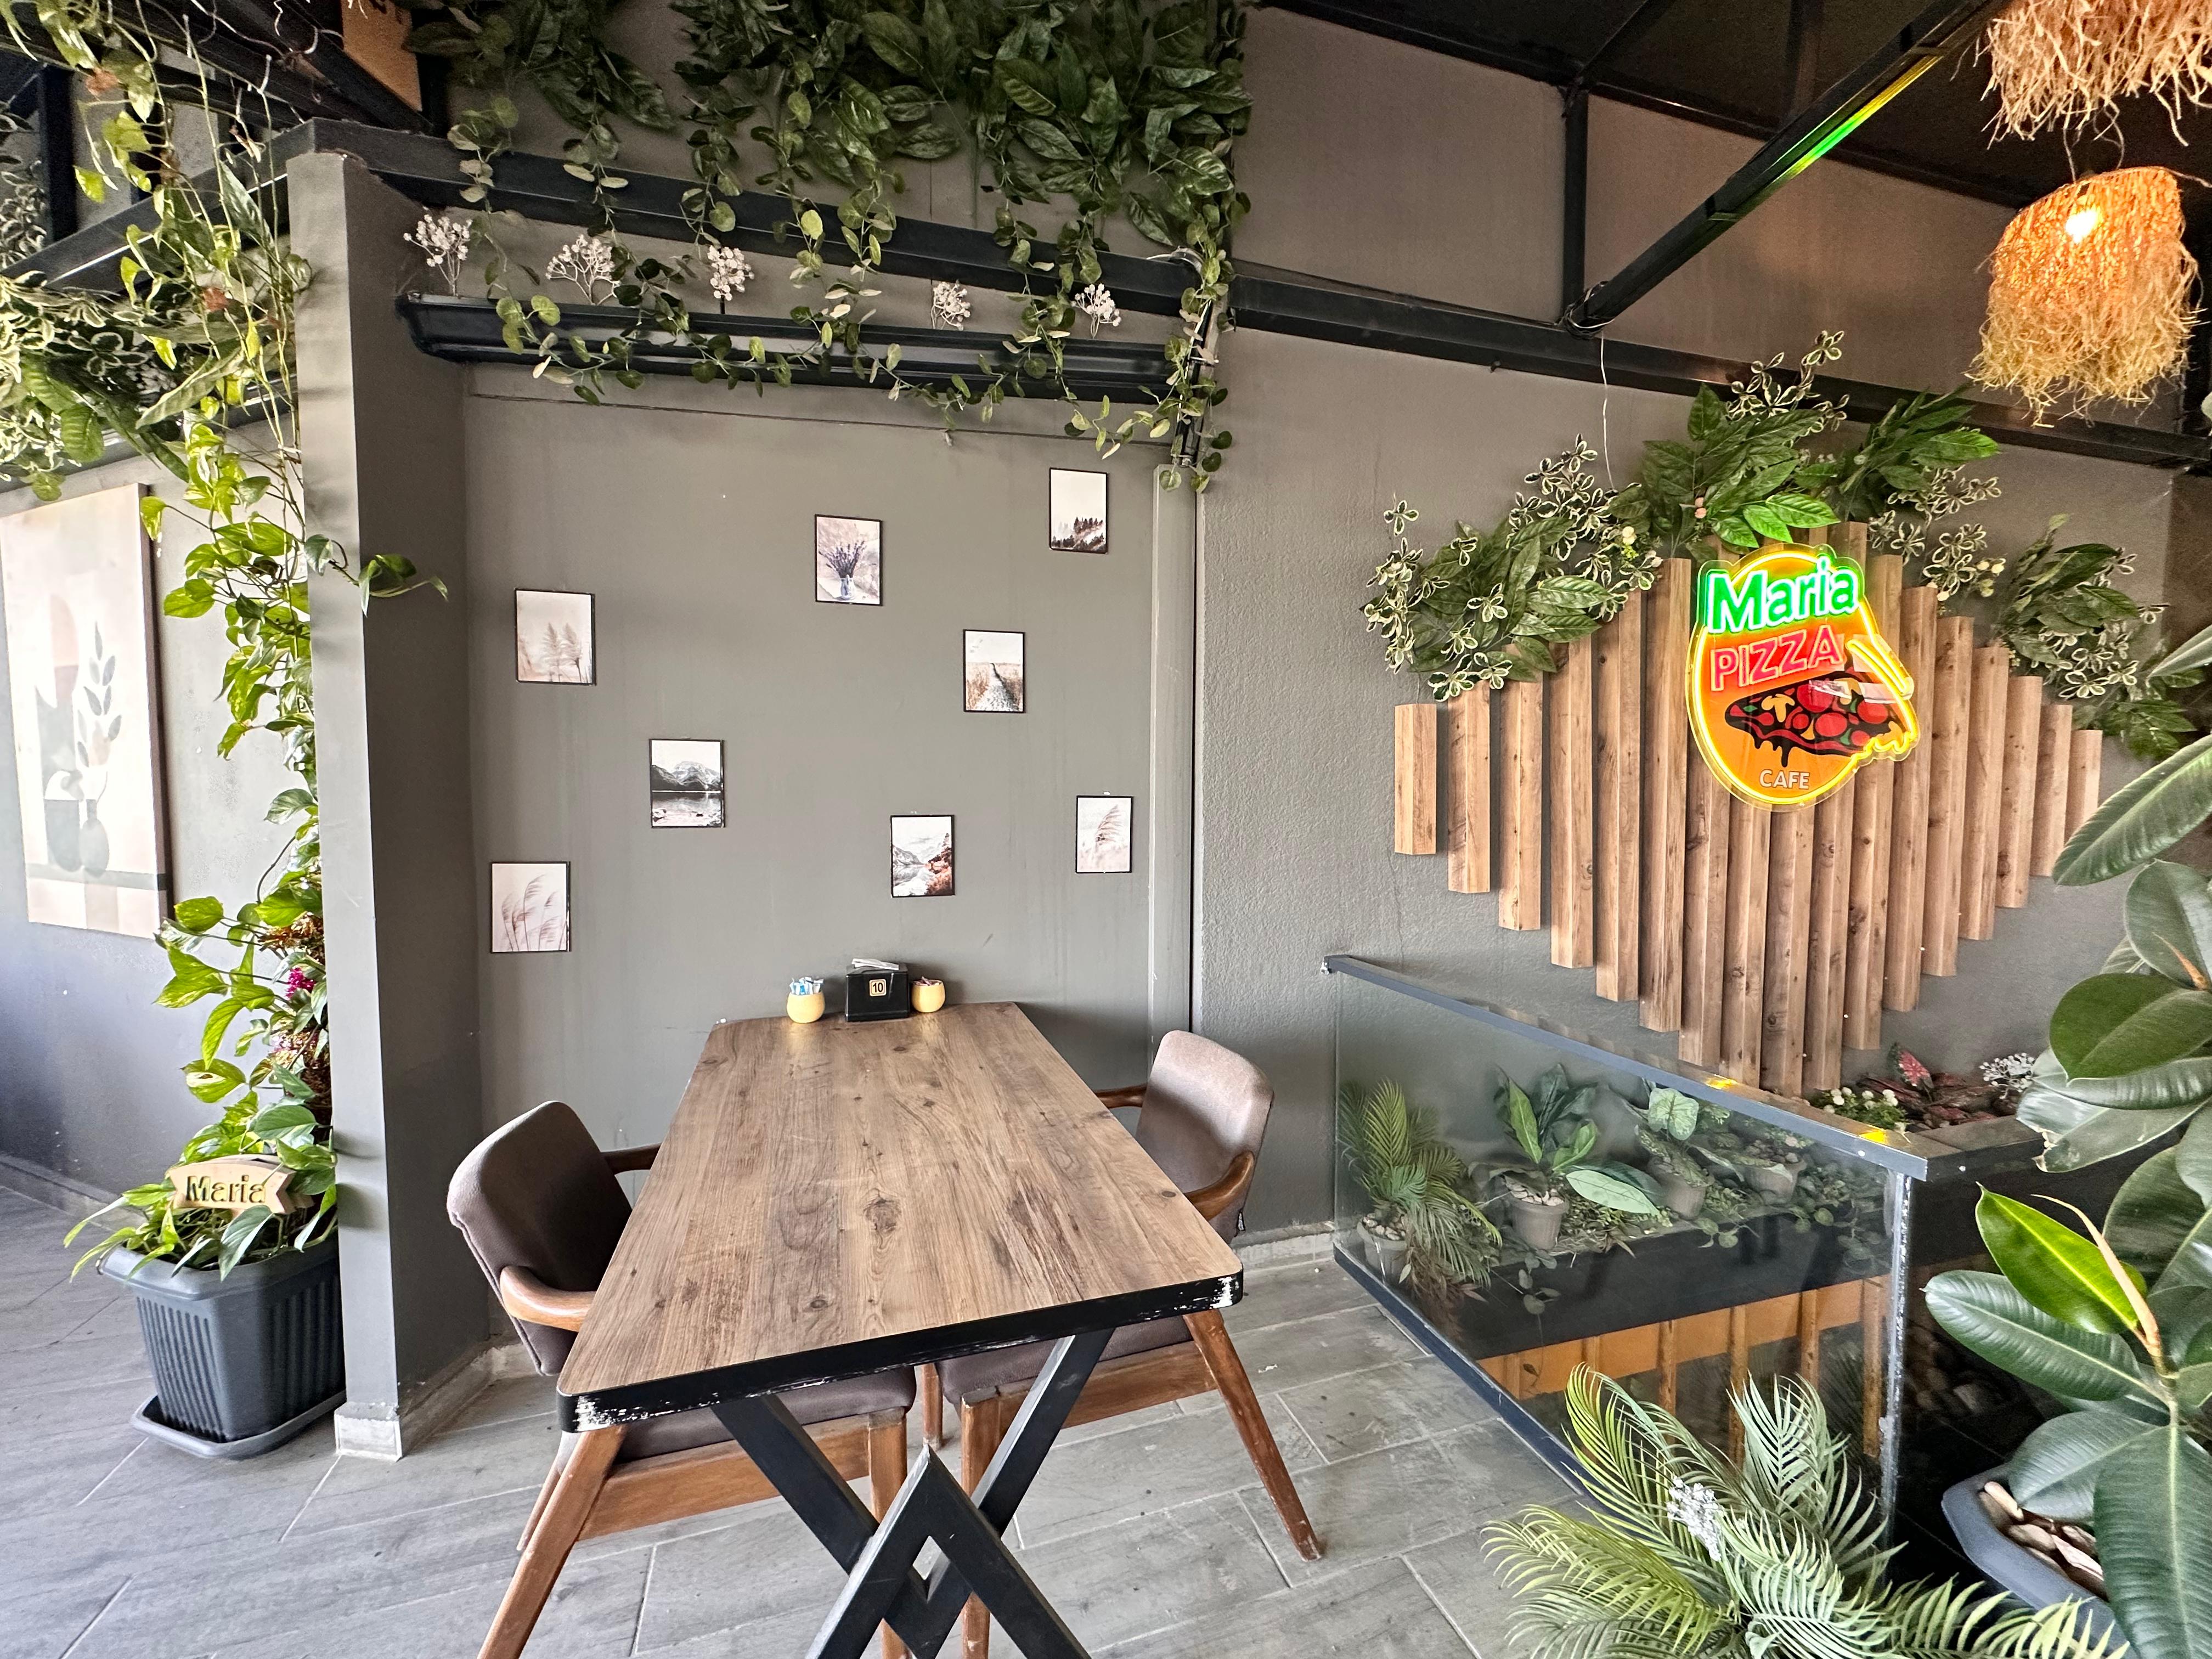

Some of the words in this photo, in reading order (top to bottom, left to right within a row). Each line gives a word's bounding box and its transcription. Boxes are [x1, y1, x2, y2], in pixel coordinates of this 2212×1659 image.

[1708, 557, 1859, 634] Maria
[1711, 624, 1842, 691] PIZZA
[1759, 769, 1810, 790] CAFE
[872, 982, 883, 993] 10
[185, 1175, 266, 1203] Maria
